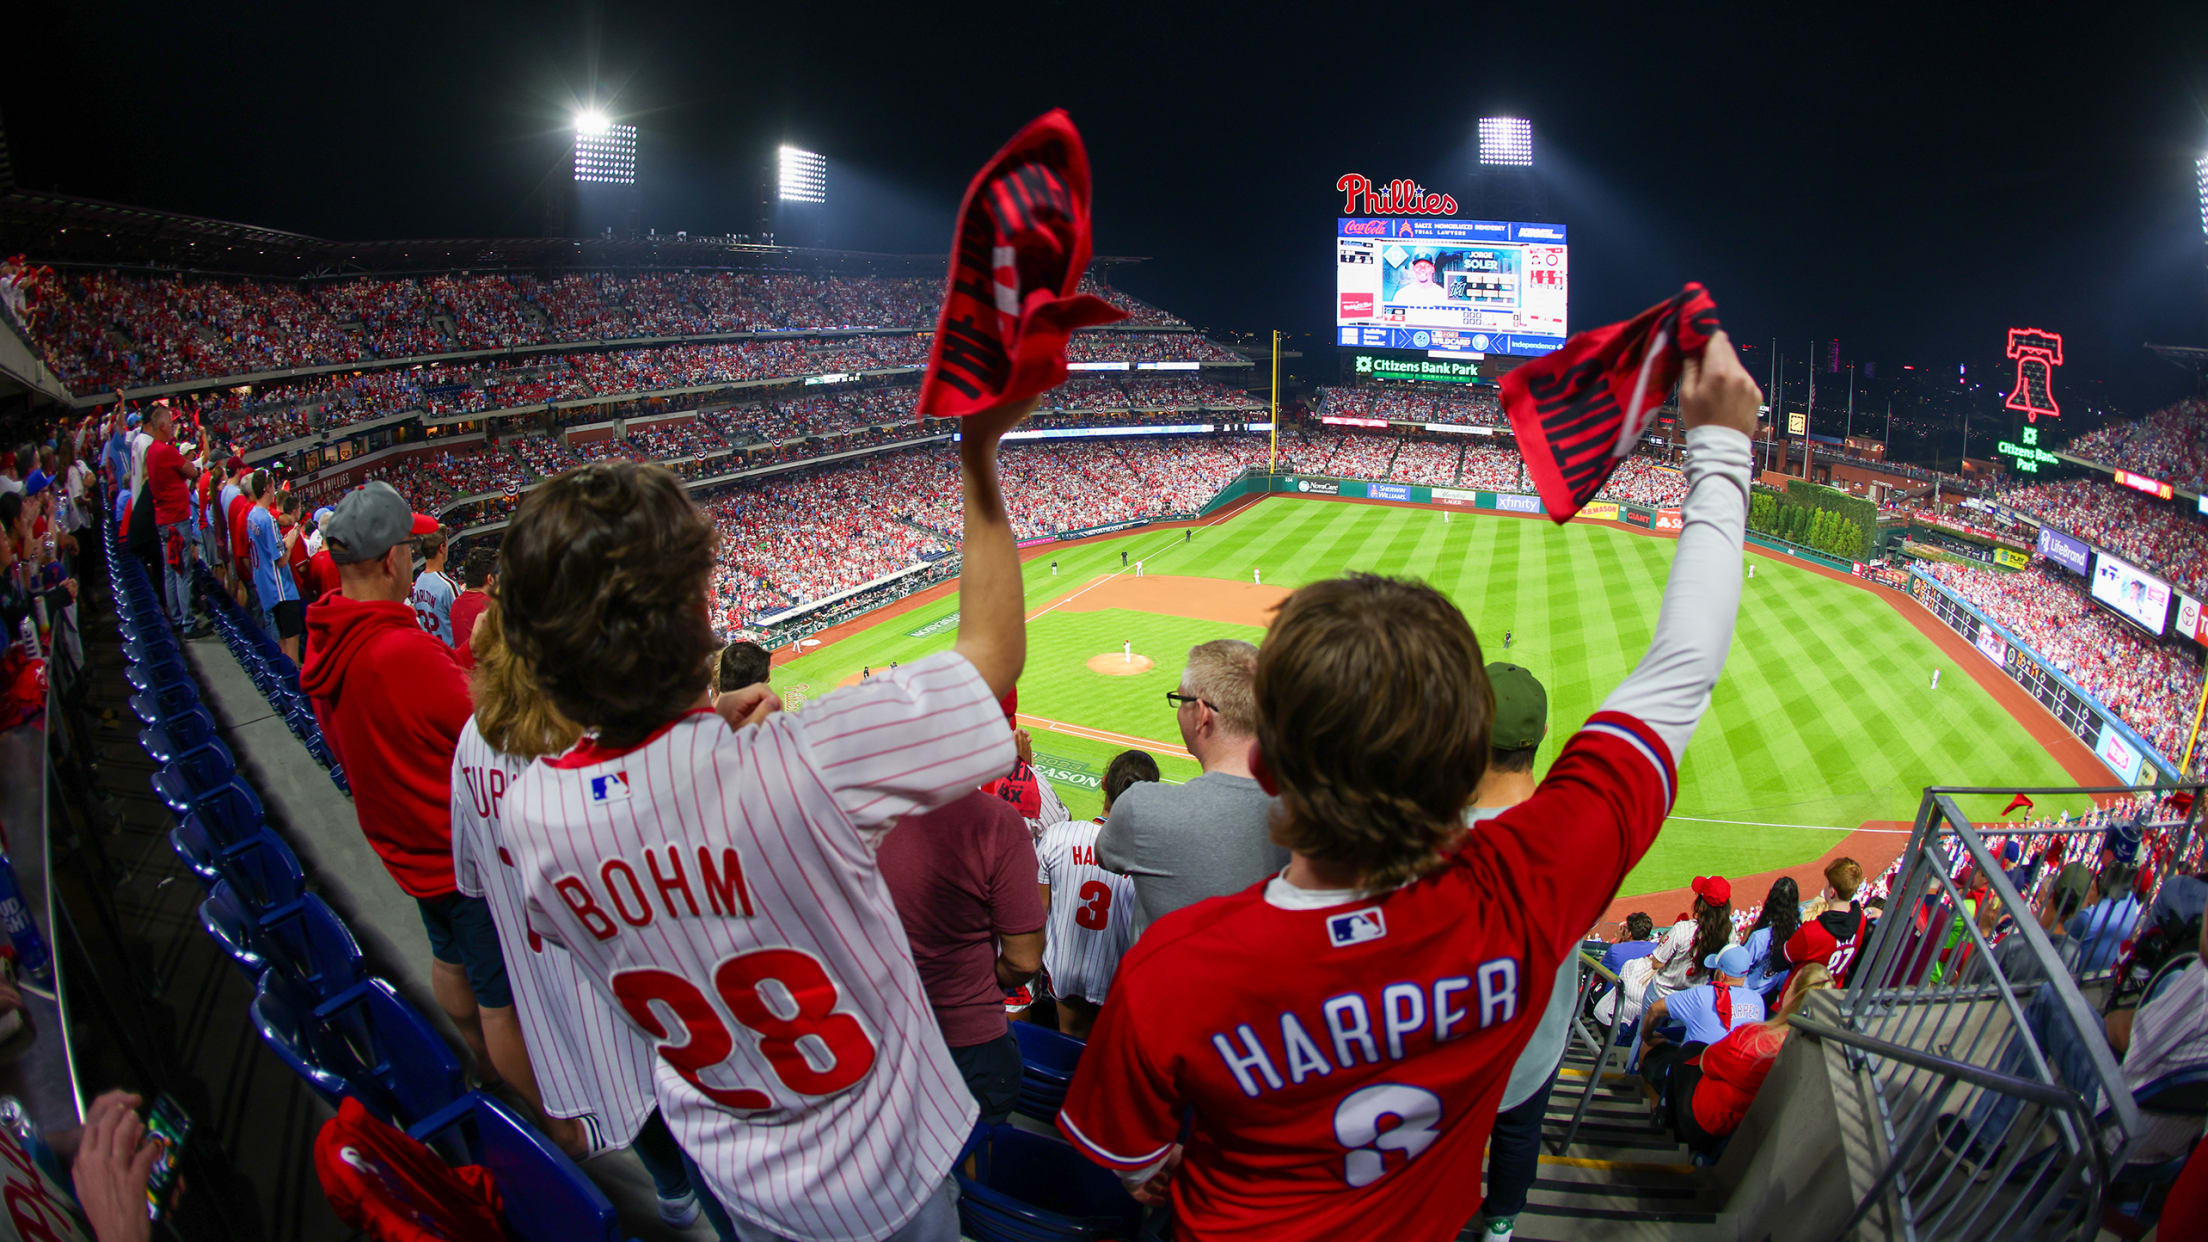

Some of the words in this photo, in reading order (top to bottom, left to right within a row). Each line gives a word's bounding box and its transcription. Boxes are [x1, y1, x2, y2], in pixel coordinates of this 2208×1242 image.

[1337, 173, 1458, 215] Phillies
[1463, 259, 1498, 270] SOLER
[1511, 341, 1556, 349] Independence
[1373, 360, 1420, 372] Citizens
[1421, 362, 1450, 374] Bank
[1452, 363, 1478, 376] Park
[1998, 441, 2035, 459] Citizens
[2016, 457, 2038, 473] Park
[1310, 481, 1338, 491] NovaCare
[1379, 485, 1406, 493] SHERWIN
[1499, 495, 1538, 511] xfinity
[1627, 512, 1650, 524] GIANT
[2051, 537, 2086, 567] LifeBrand
[551, 844, 756, 942] BOHM
[1075, 880, 1112, 931] 3
[609, 948, 877, 1111] 28
[1211, 956, 1518, 1097] HARPER
